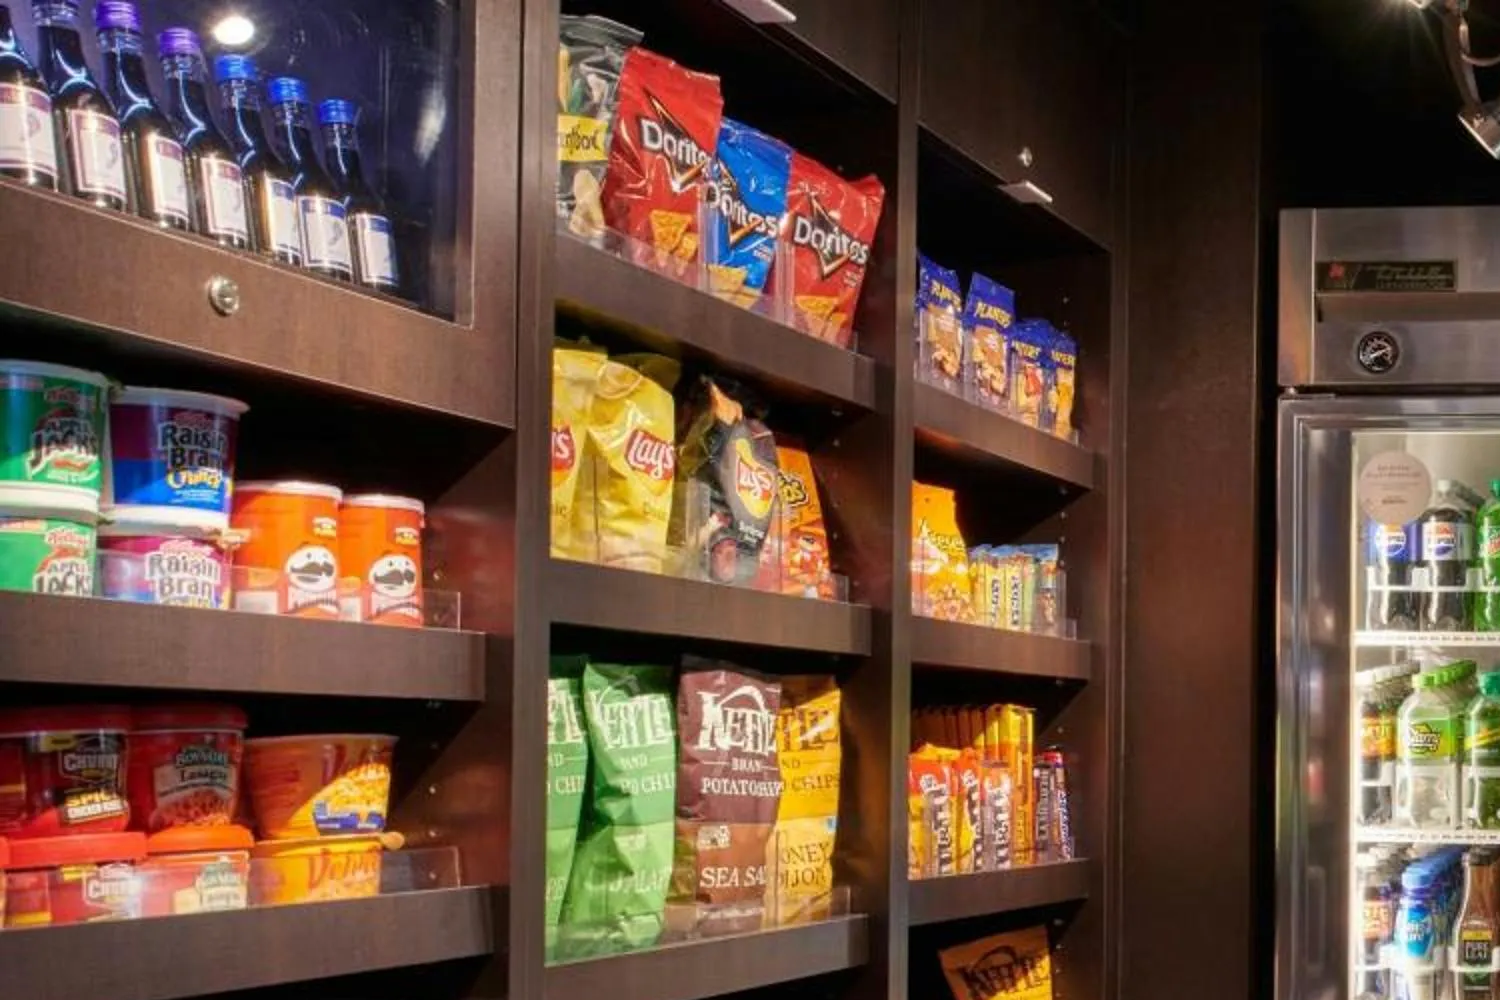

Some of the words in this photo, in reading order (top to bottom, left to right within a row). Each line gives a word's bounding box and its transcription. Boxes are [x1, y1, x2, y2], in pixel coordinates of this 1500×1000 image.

[794, 215, 869, 264] Doritos
[701, 867, 741, 891] SEA
[746, 865, 769, 890] SA
